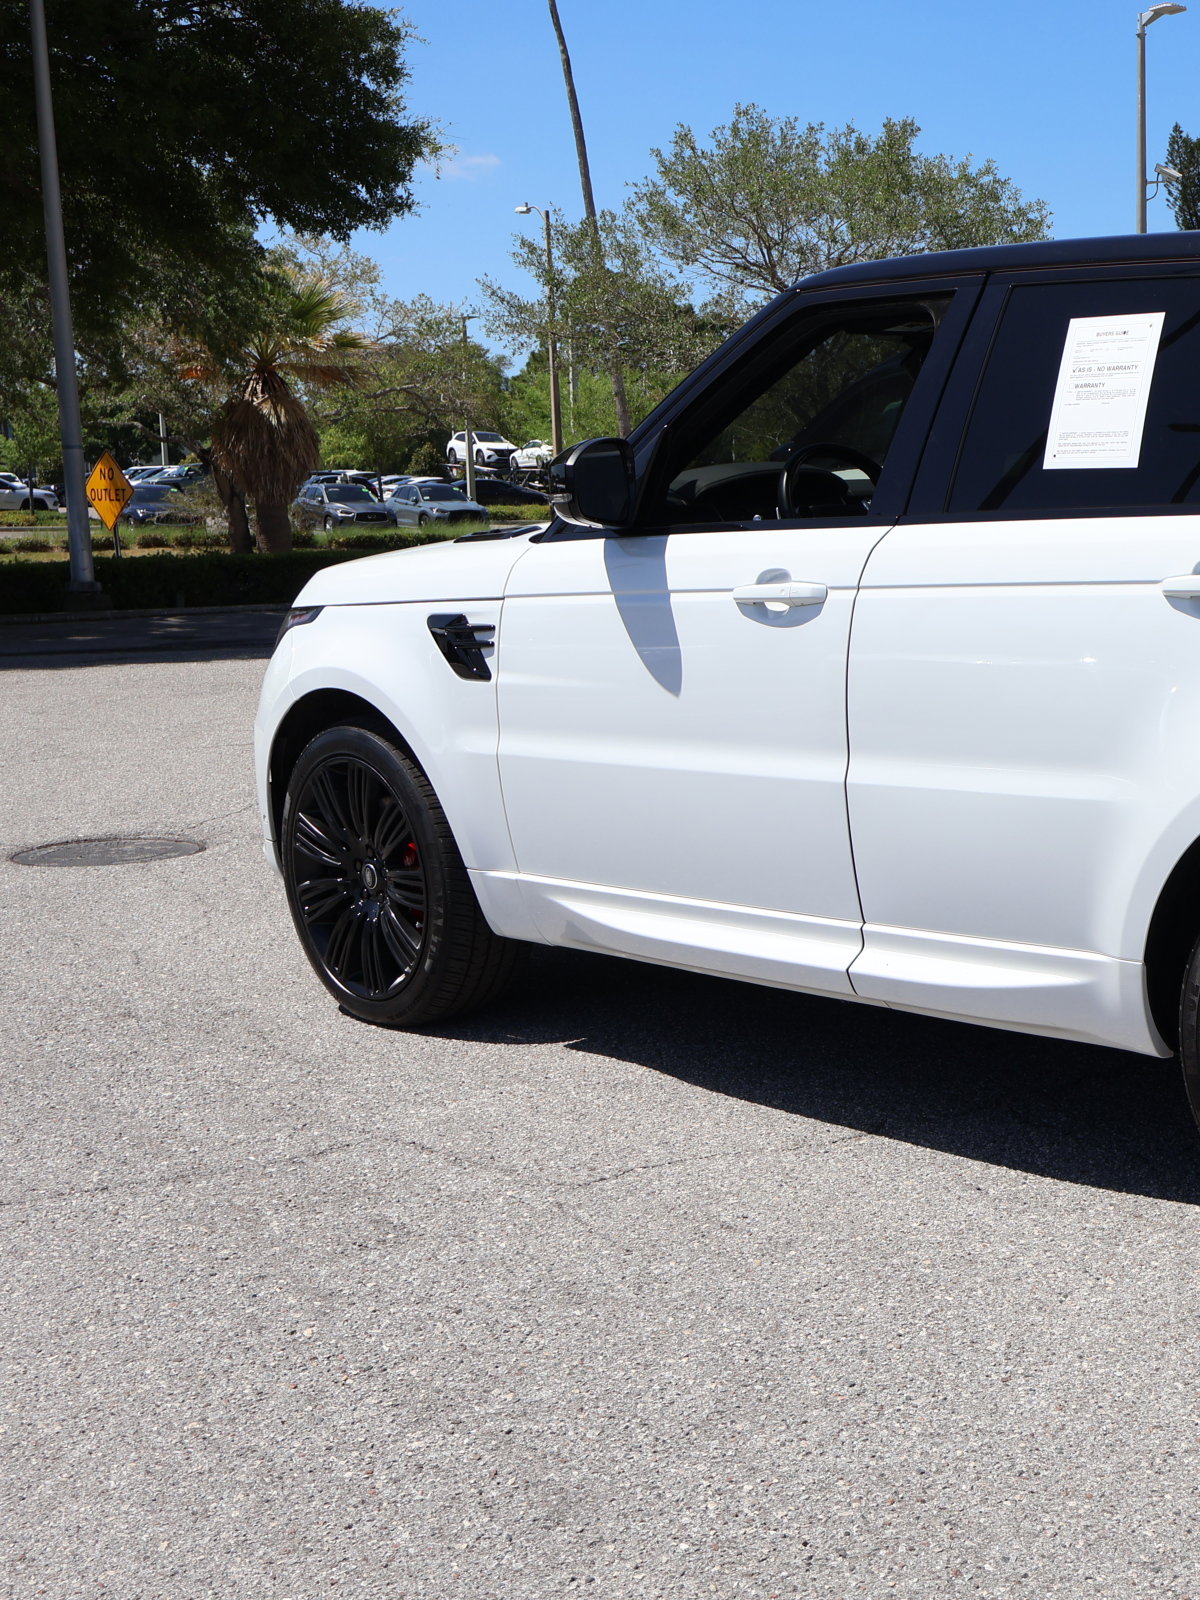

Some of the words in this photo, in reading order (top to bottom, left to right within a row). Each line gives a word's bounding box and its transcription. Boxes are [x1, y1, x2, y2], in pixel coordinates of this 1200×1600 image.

[1096, 365, 1106, 373] NO
[99, 467, 115, 481] NO
[90, 488, 127, 502] OUTLET
